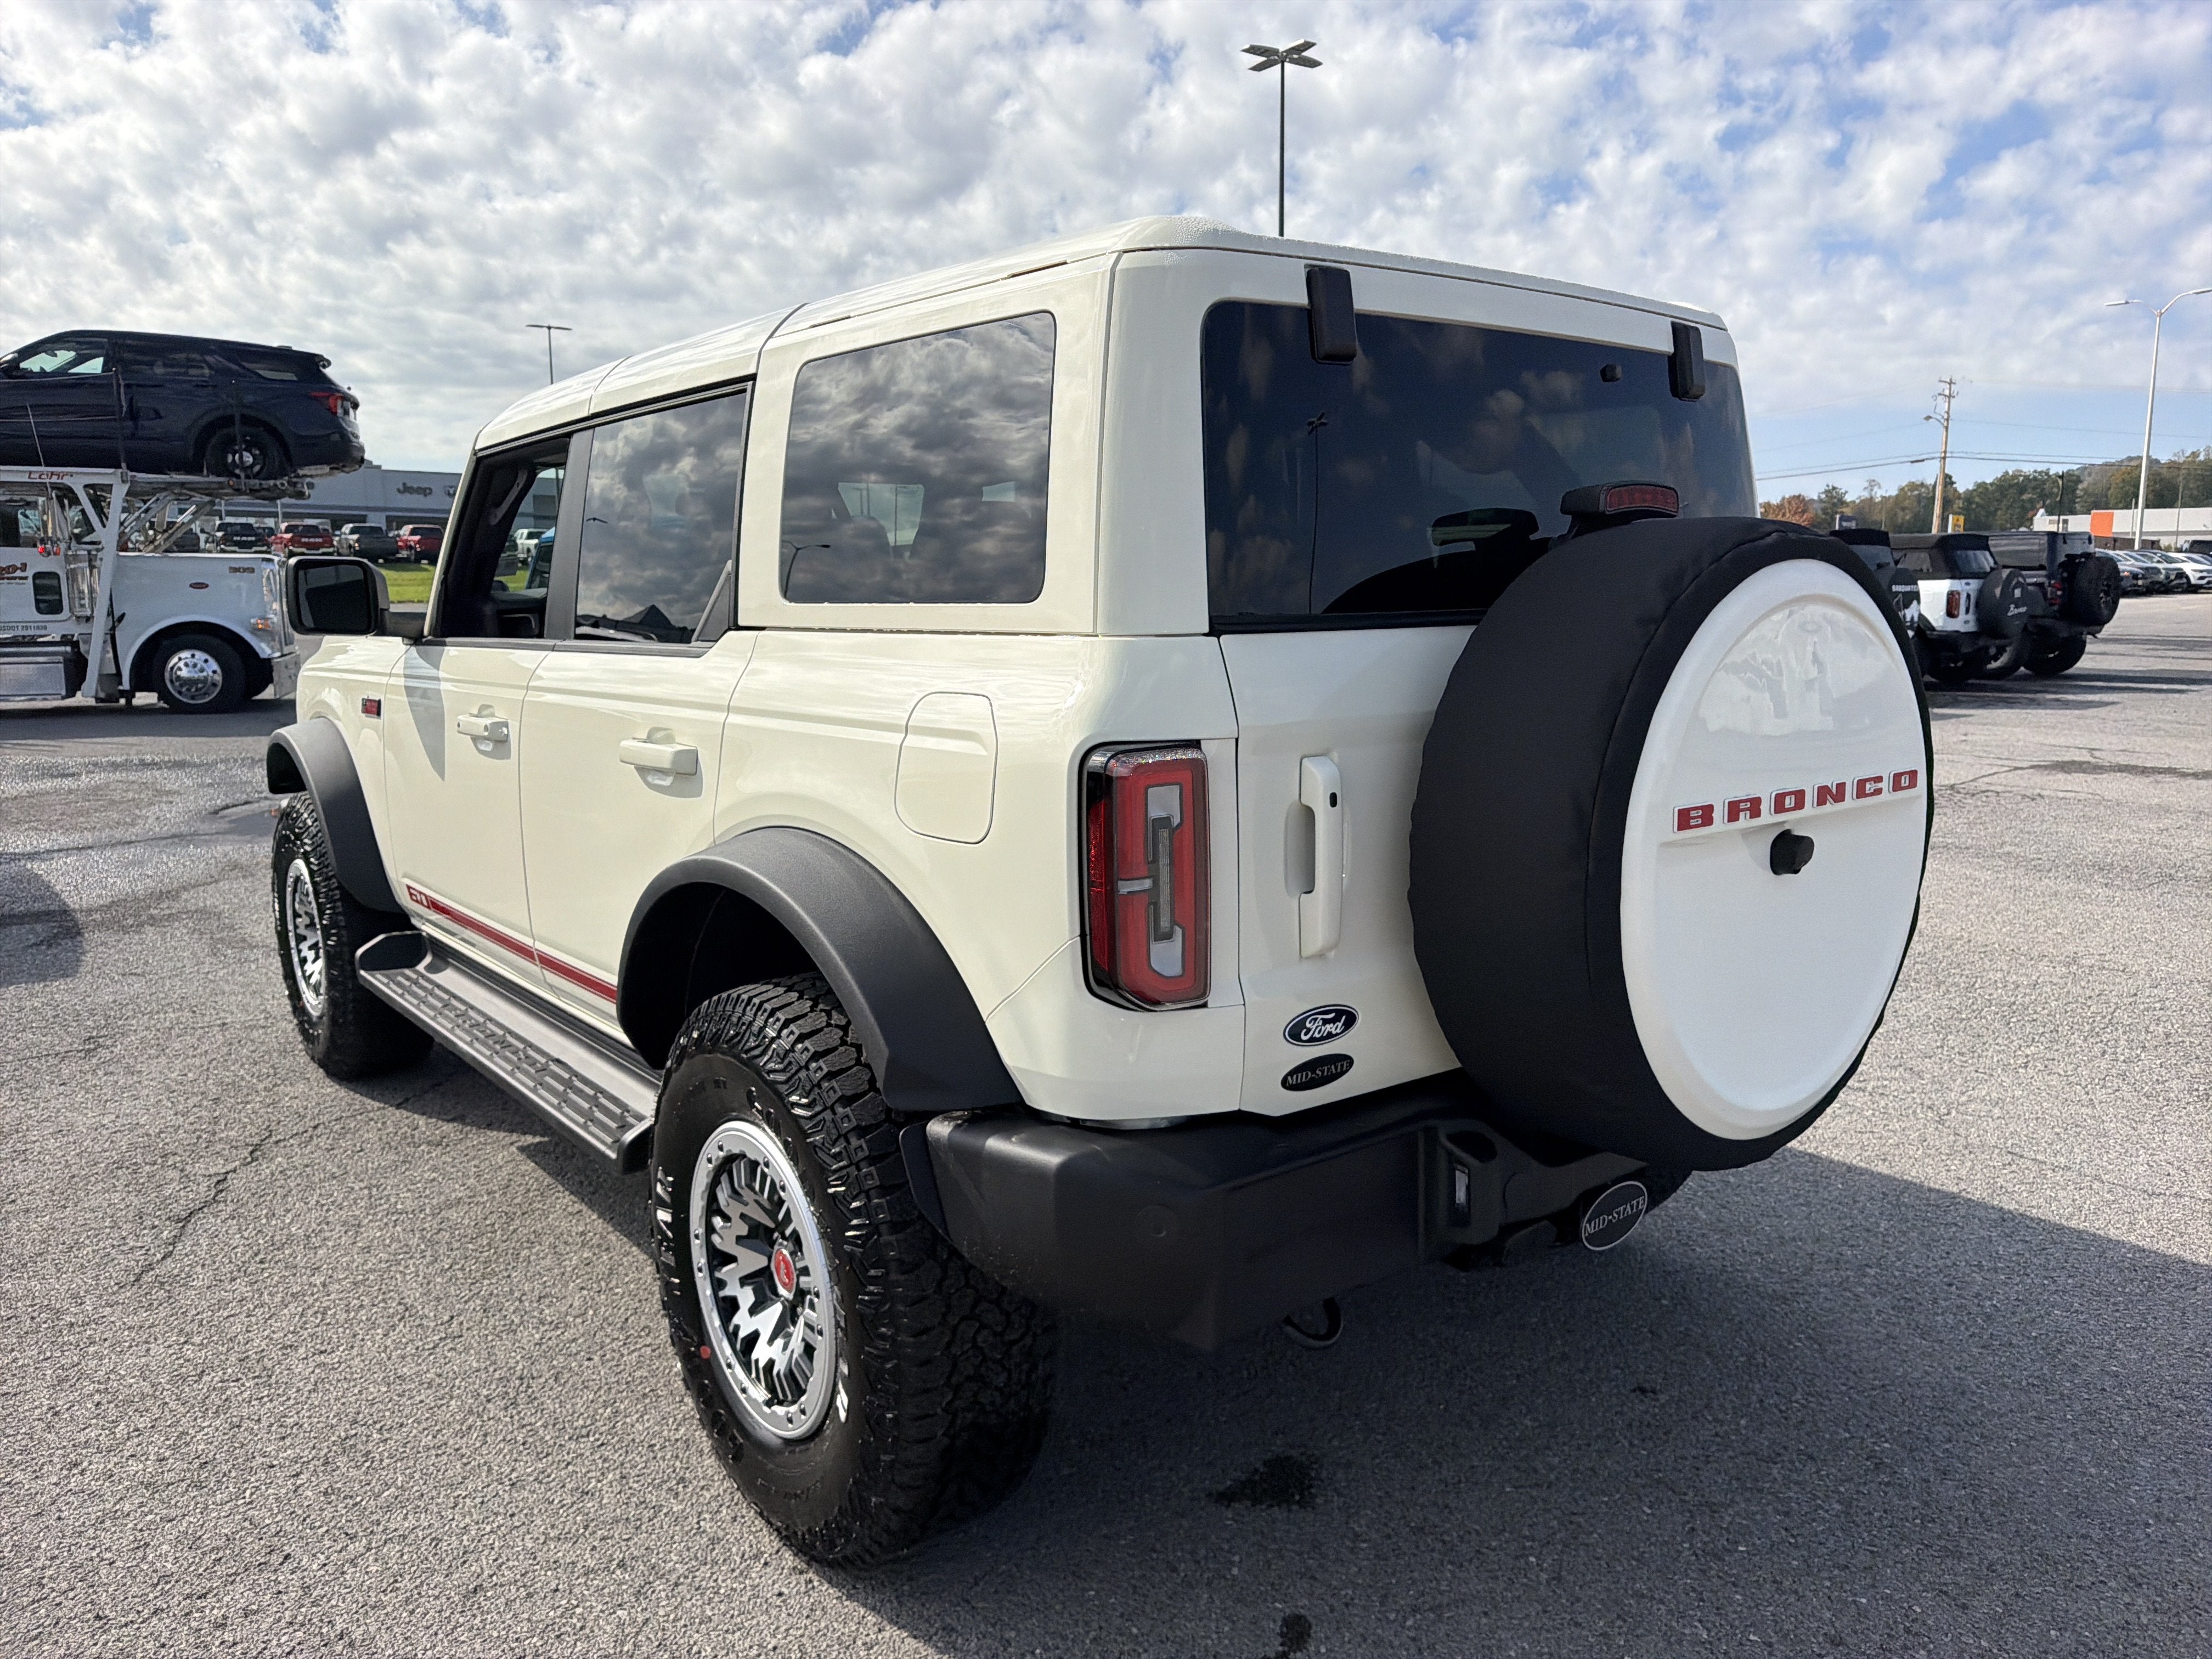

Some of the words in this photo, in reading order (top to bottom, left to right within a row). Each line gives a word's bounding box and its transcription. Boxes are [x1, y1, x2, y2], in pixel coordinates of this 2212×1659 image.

[396, 482, 432, 497] Jeep
[1672, 769, 1918, 833] BRONCO
[1301, 1013, 1346, 1041] Ford
[1285, 1059, 1351, 1087] MID-STATE
[1585, 1196, 1645, 1237] MID-STATE
